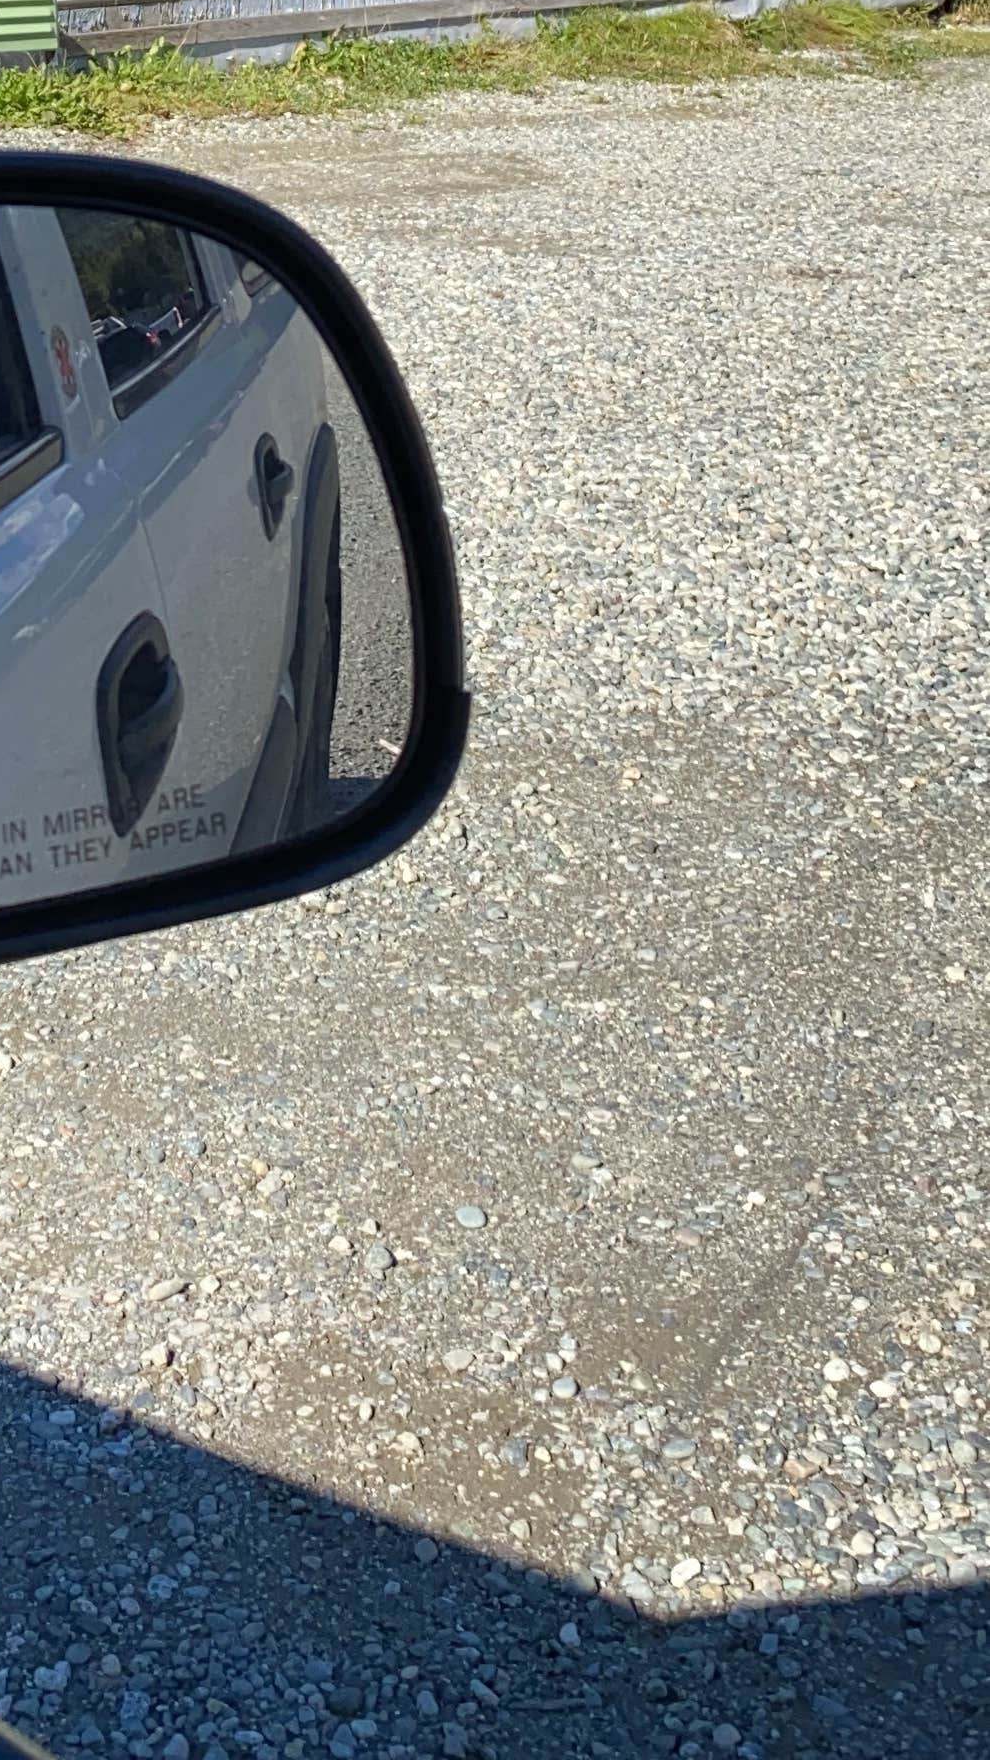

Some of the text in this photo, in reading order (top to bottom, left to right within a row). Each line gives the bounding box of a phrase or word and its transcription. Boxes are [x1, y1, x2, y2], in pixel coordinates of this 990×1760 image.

[2, 820, 27, 844] IN
[157, 783, 207, 813] ARE
[49, 837, 112, 869] THEY
[130, 813, 227, 850] APPEAR
